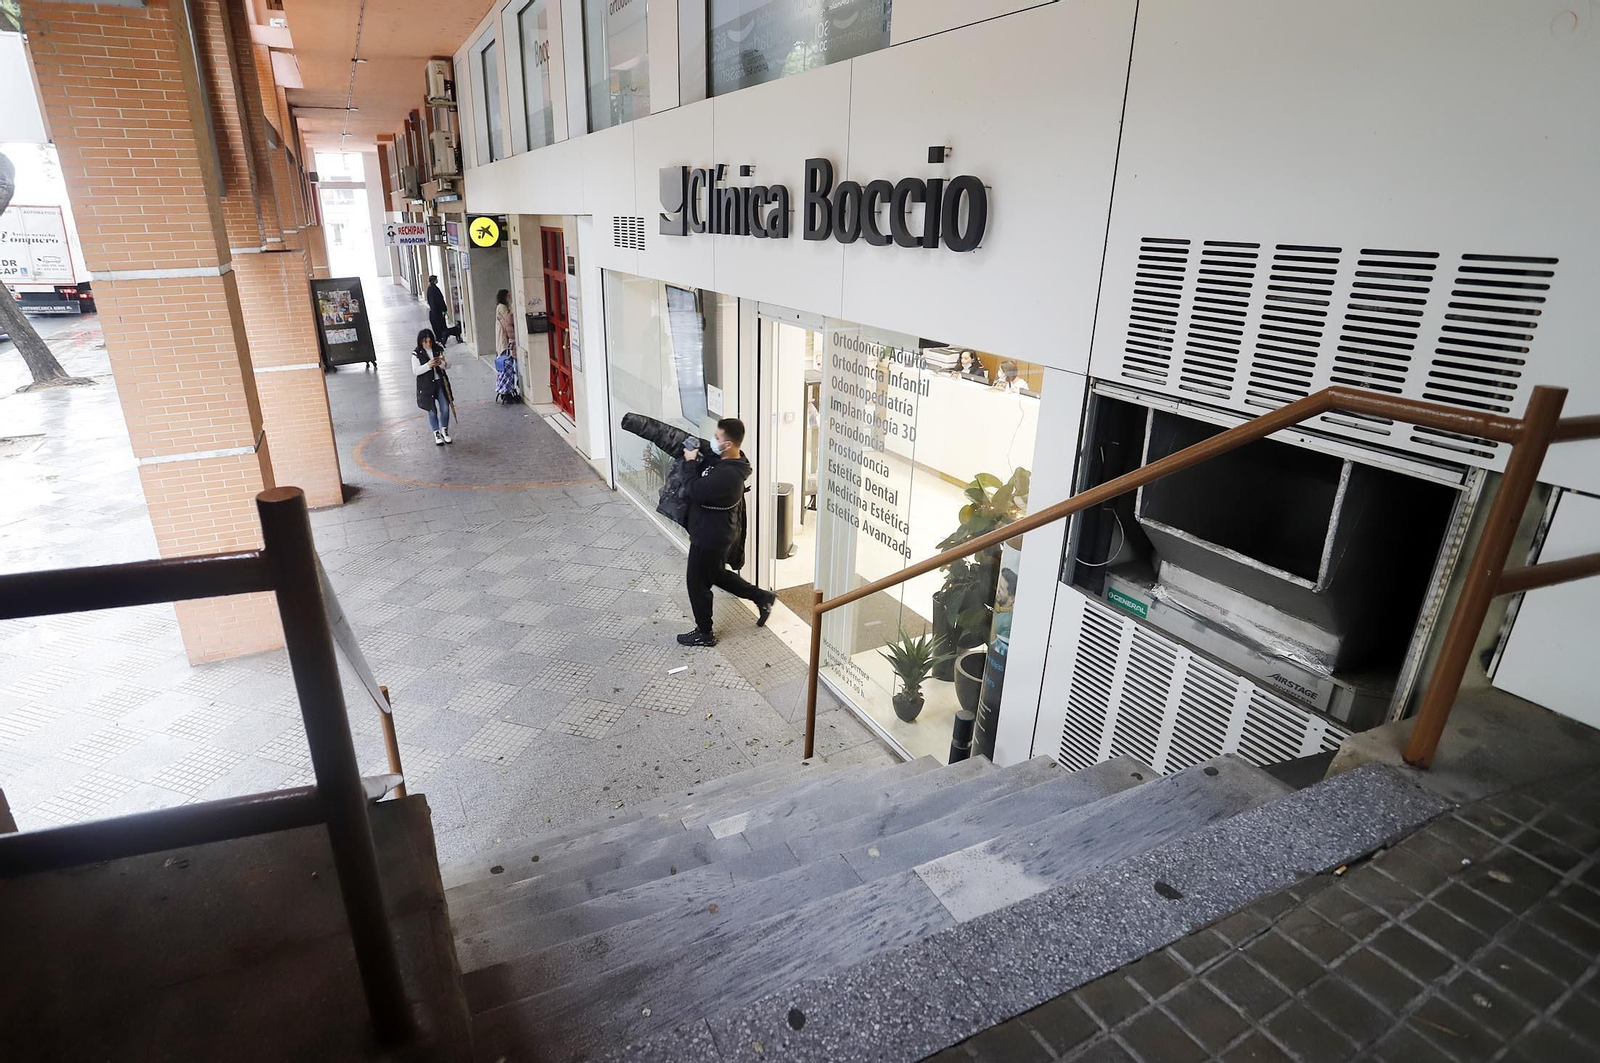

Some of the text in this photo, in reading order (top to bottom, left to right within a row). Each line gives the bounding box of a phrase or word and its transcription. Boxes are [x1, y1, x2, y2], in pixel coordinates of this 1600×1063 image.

[690, 145, 988, 252] Clínica Boccio
[0, 259, 17, 267] DR
[833, 331, 927, 370] Ortodoncia Adulto
[832, 353, 930, 397] Ortodoncia Infantil
[831, 375, 913, 417] Odontopediatría
[829, 417, 885, 453] Periodoncia
[830, 395, 917, 442] Implantología 3D
[828, 438, 889, 478] Prostodoncia
[828, 458, 898, 506] Estética Dental
[827, 478, 910, 535] Medicina Estética
[862, 519, 912, 559] Avanzada
[1113, 594, 1146, 615] GENERAL
[1266, 673, 1318, 700] AIRSTAGE
